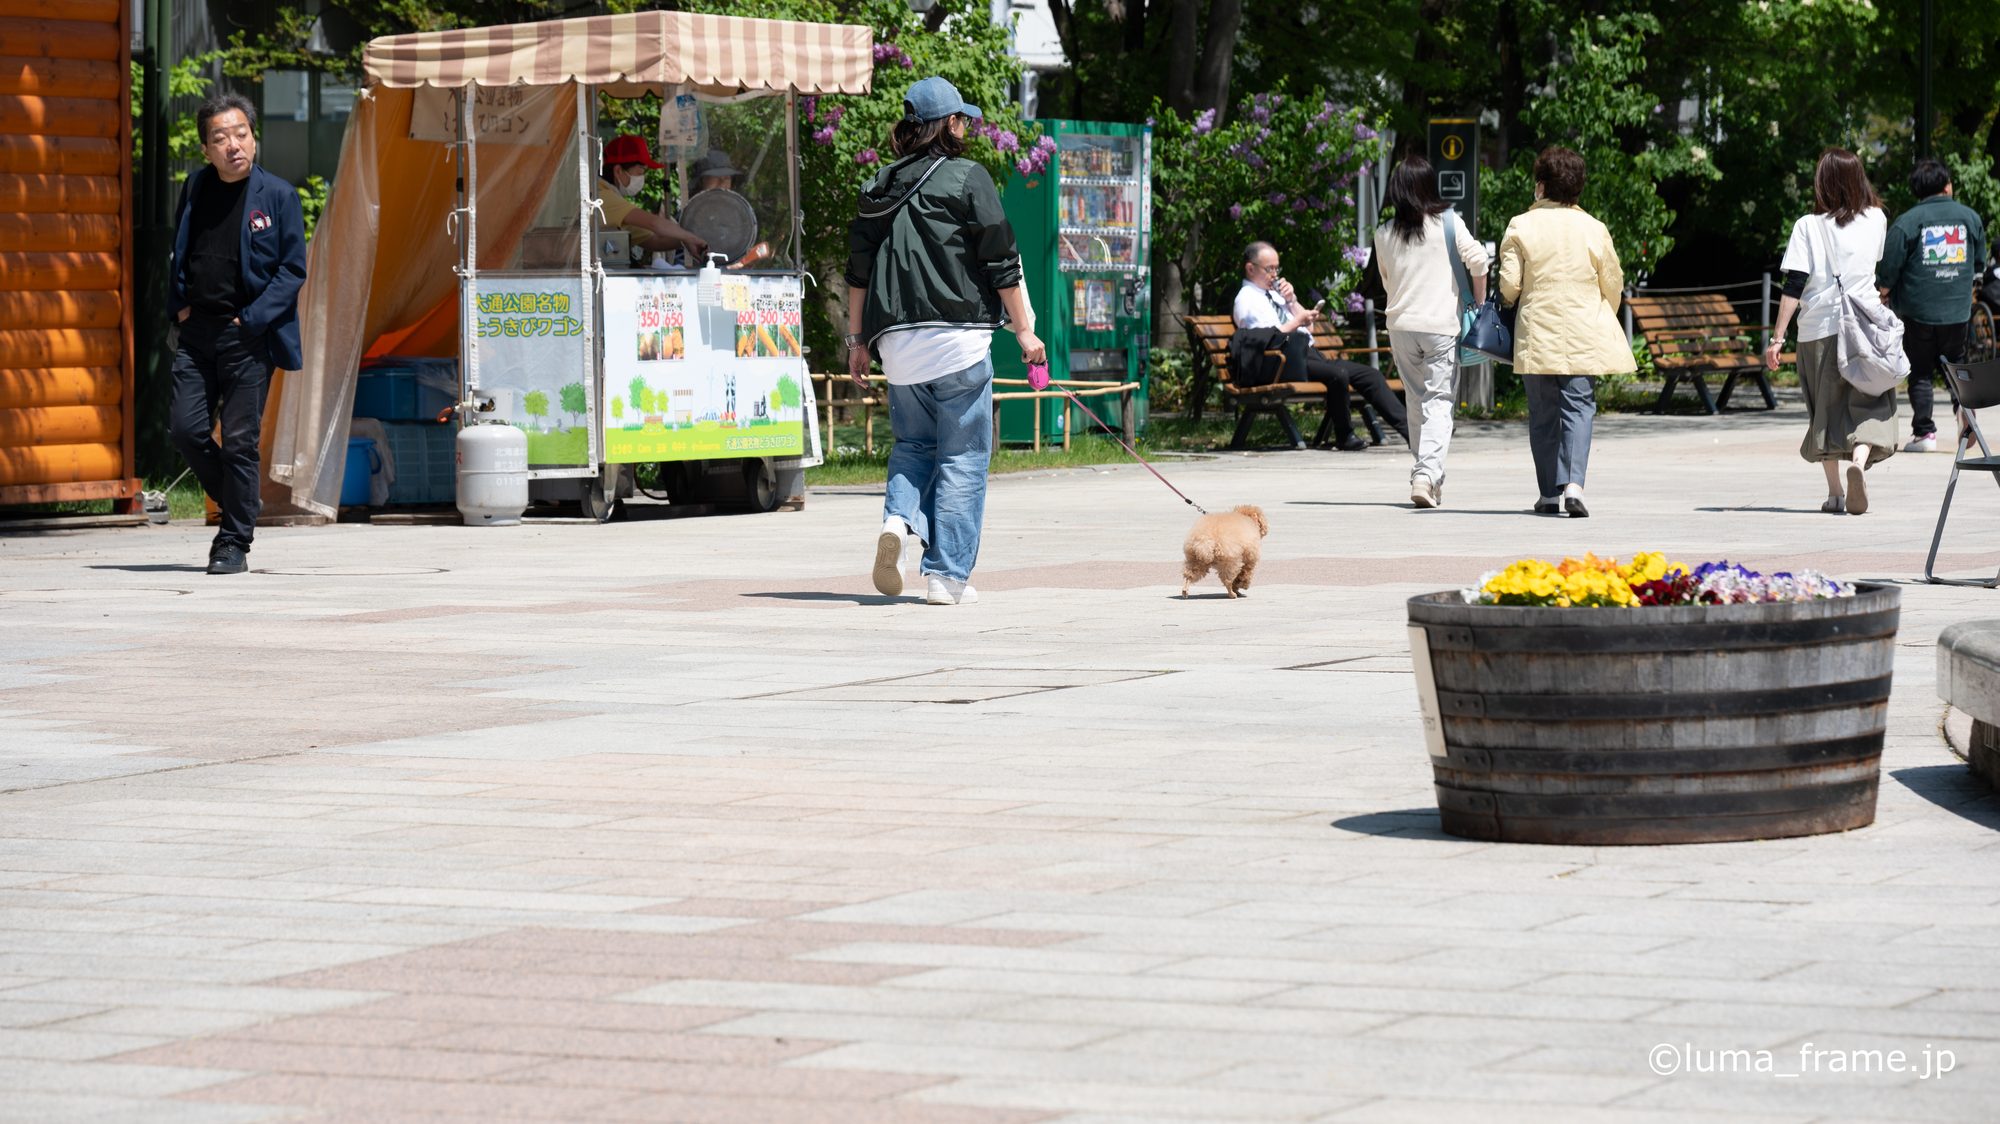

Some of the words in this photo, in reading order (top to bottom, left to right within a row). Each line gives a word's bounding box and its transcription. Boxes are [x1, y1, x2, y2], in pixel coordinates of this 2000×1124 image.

[641, 311, 660, 328] 350
[664, 312, 683, 328] 650
[737, 310, 757, 325] 600
[759, 310, 779, 325] 500
[783, 311, 801, 326] 500
